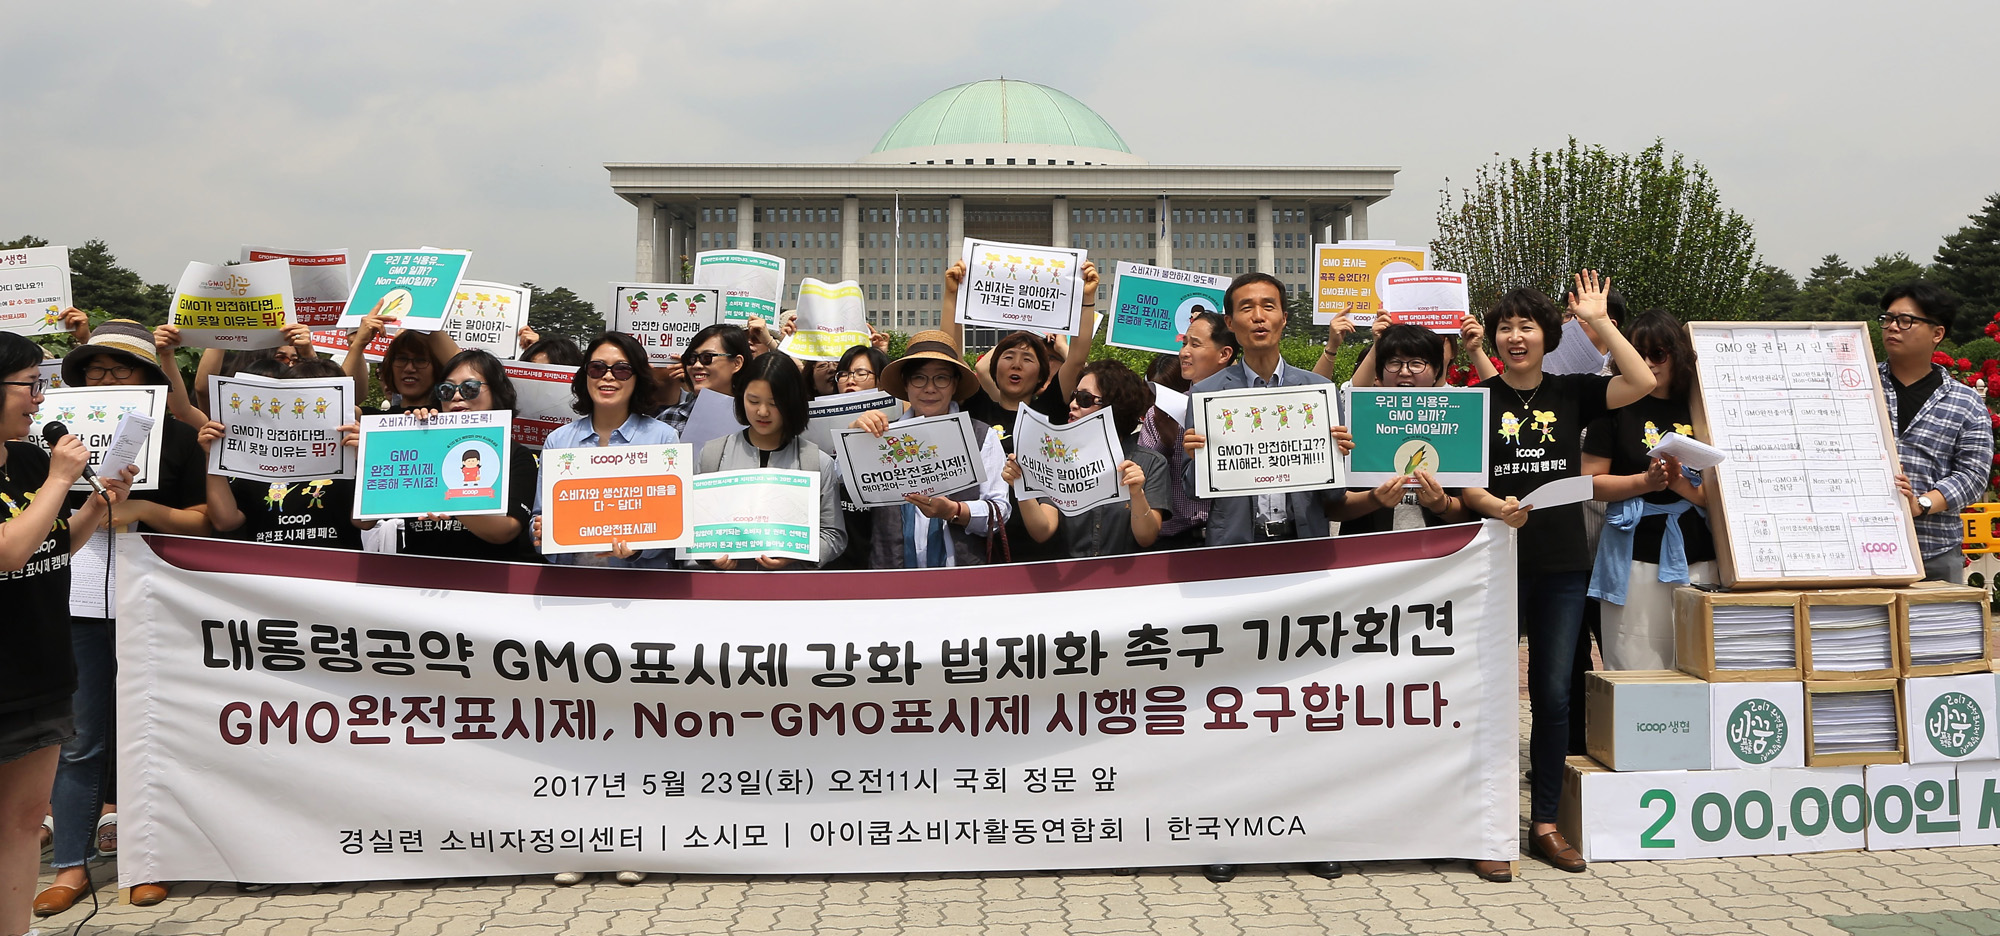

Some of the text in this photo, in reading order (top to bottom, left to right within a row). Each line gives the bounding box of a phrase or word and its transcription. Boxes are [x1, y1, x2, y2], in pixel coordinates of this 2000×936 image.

[4, 253, 27, 266] 생협
[384, 255, 401, 265] 우리
[402, 255, 412, 265] 집
[1322, 258, 1367, 268] GMO 표시는
[388, 266, 433, 276] GMO 일까?
[1130, 264, 1218, 286] 소비자가 불안하지 않도록!
[1320, 272, 1370, 282] 꼭꼭 숨었다?!
[15, 282, 44, 291] 없나요?!
[375, 276, 438, 287] Non-GMO일까?
[973, 279, 1067, 300] 소비자는 알아야지~
[1321, 287, 1359, 297] GMO표시는
[180, 299, 283, 312] GMO가 안전하다면...
[980, 293, 1056, 312] 가격도! GMO도!
[1136, 293, 1159, 306] GMO
[1319, 301, 1345, 310] 소비자의
[1356, 301, 1371, 310] 권리
[1002, 312, 1033, 322] icoop 생협
[1121, 303, 1171, 321] 완전 표시제.
[174, 311, 286, 327] 표시 못할 이유는 뭐?
[466, 319, 513, 332] 알아야지~
[632, 320, 660, 331] 안전한
[1117, 314, 1172, 331] 존중해 주시죠!
[466, 332, 501, 343] GMO도!
[660, 333, 673, 347] 왜
[1715, 342, 1743, 353] GMO
[1375, 395, 1397, 408] 우리
[1401, 396, 1412, 408] 집
[378, 416, 417, 428] 소비자가
[461, 413, 493, 424] 않도록!
[540, 414, 558, 423] icoop
[1389, 410, 1446, 422] GMO 일까?
[231, 424, 335, 442] GMO가 안전하다면...
[1376, 423, 1459, 435] Non-GMO일까?
[227, 438, 337, 458] 표시 못할 이유는 뭐?
[1217, 438, 1326, 457] GMO가 안전하다고??
[1516, 447, 1546, 459] icoop
[390, 449, 419, 462] GMO
[590, 451, 648, 466] icoop 생협
[1217, 452, 1325, 471] 표시해라. 찾아먹게!!!
[259, 464, 279, 473] icoop
[371, 463, 436, 477] 완전 표시제.
[860, 455, 967, 485] GMO완전표시제!
[1021, 454, 1106, 482] 소비자는 알아야지!
[366, 477, 439, 491] 존중해 주시죠!
[908, 479, 918, 488] 안
[1058, 476, 1100, 494] GMO도!
[1254, 474, 1290, 484] icoop 생협
[558, 483, 678, 502] 소비자와 생산자의 마음을
[594, 498, 642, 512] 다 담다!
[278, 514, 312, 526] icoop
[579, 522, 657, 538] GMO완전표시제!
[1862, 542, 1898, 554] icoop
[201, 600, 1456, 689] 대통령공약 GMO표시제 강화 법제화 촉구 기자회견
[218, 681, 1462, 746] GMO완전표시제, Non-GMO표시제 시행을 요구합니다.
[1636, 720, 1691, 734] icoop 생협
[533, 766, 1118, 799] 2017년 5월 23일(화) 오전11시 국회 정문 앞
[338, 813, 1307, 856] 경실련 소비자정의센터 소시모 아이쿱소비자활동연합회 한국YMCA
